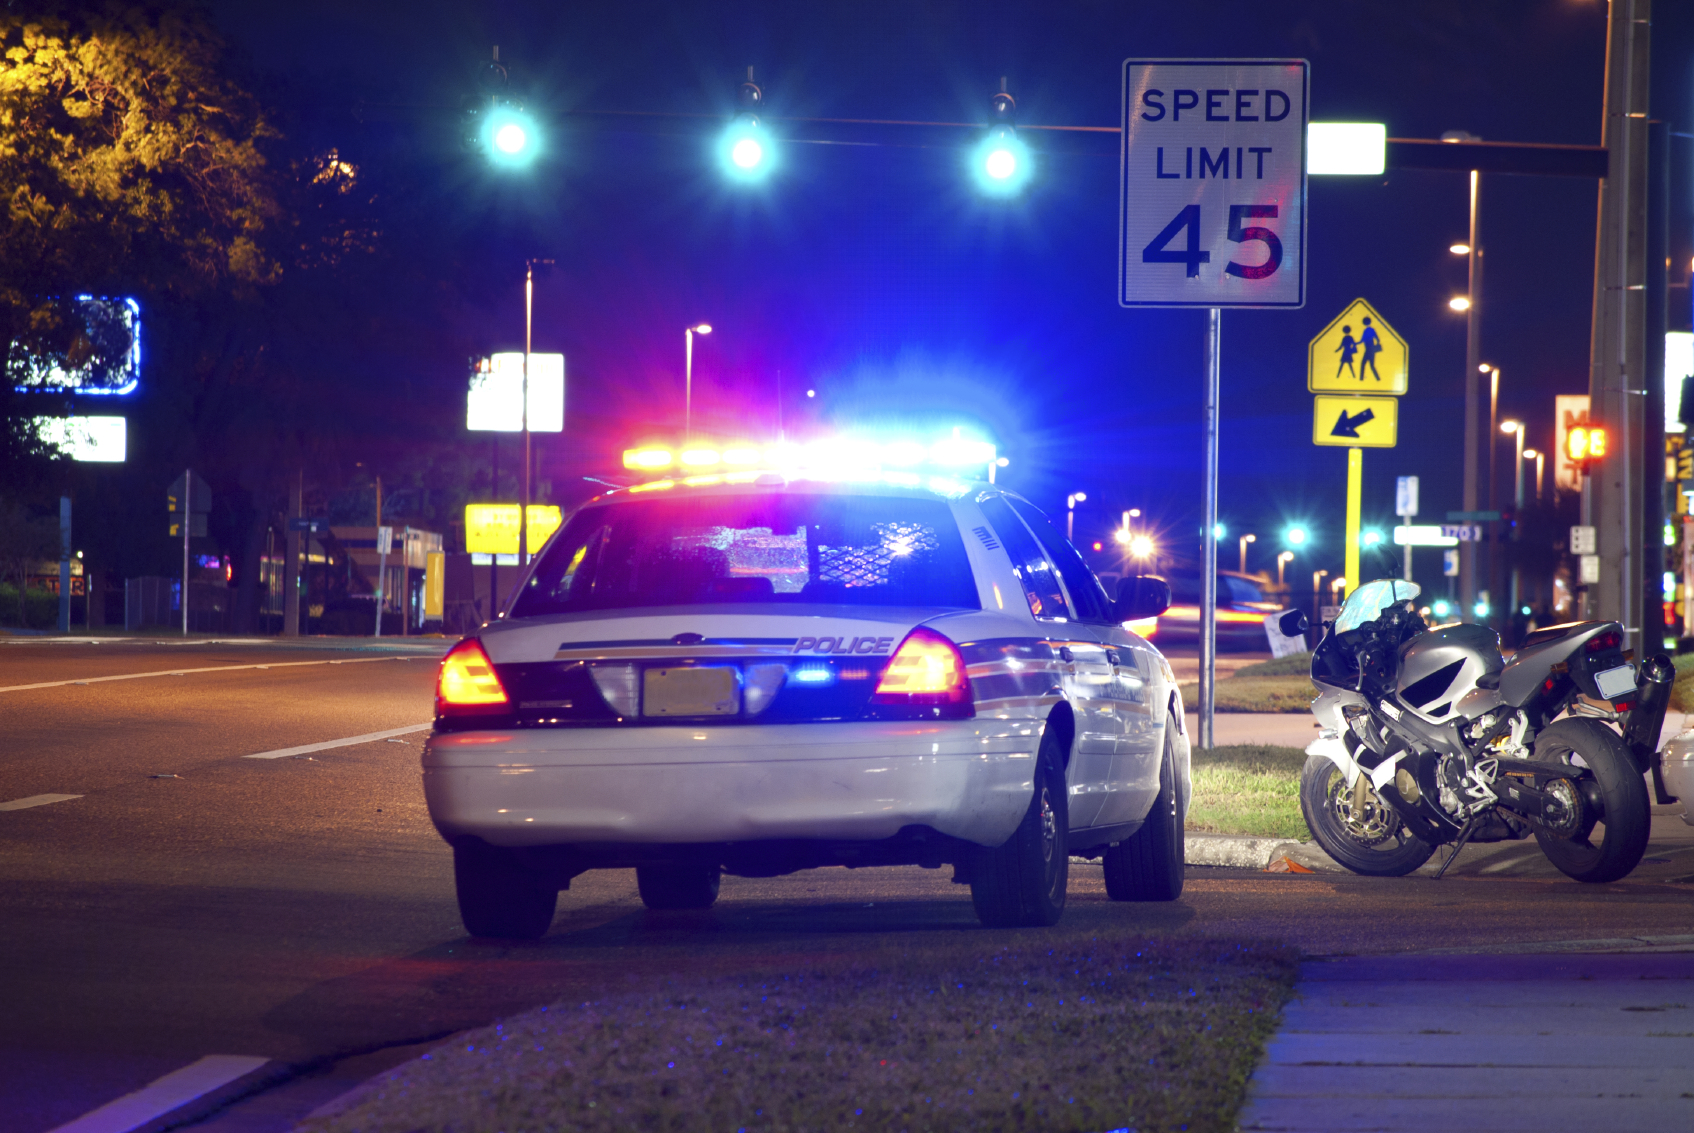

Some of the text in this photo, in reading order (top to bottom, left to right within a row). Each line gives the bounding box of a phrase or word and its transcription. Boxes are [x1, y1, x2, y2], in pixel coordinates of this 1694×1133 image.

[1141, 88, 1291, 122] SPEED
[1156, 147, 1272, 179] LIMIT
[1142, 204, 1283, 280] 45
[793, 636, 895, 654] POLICE
